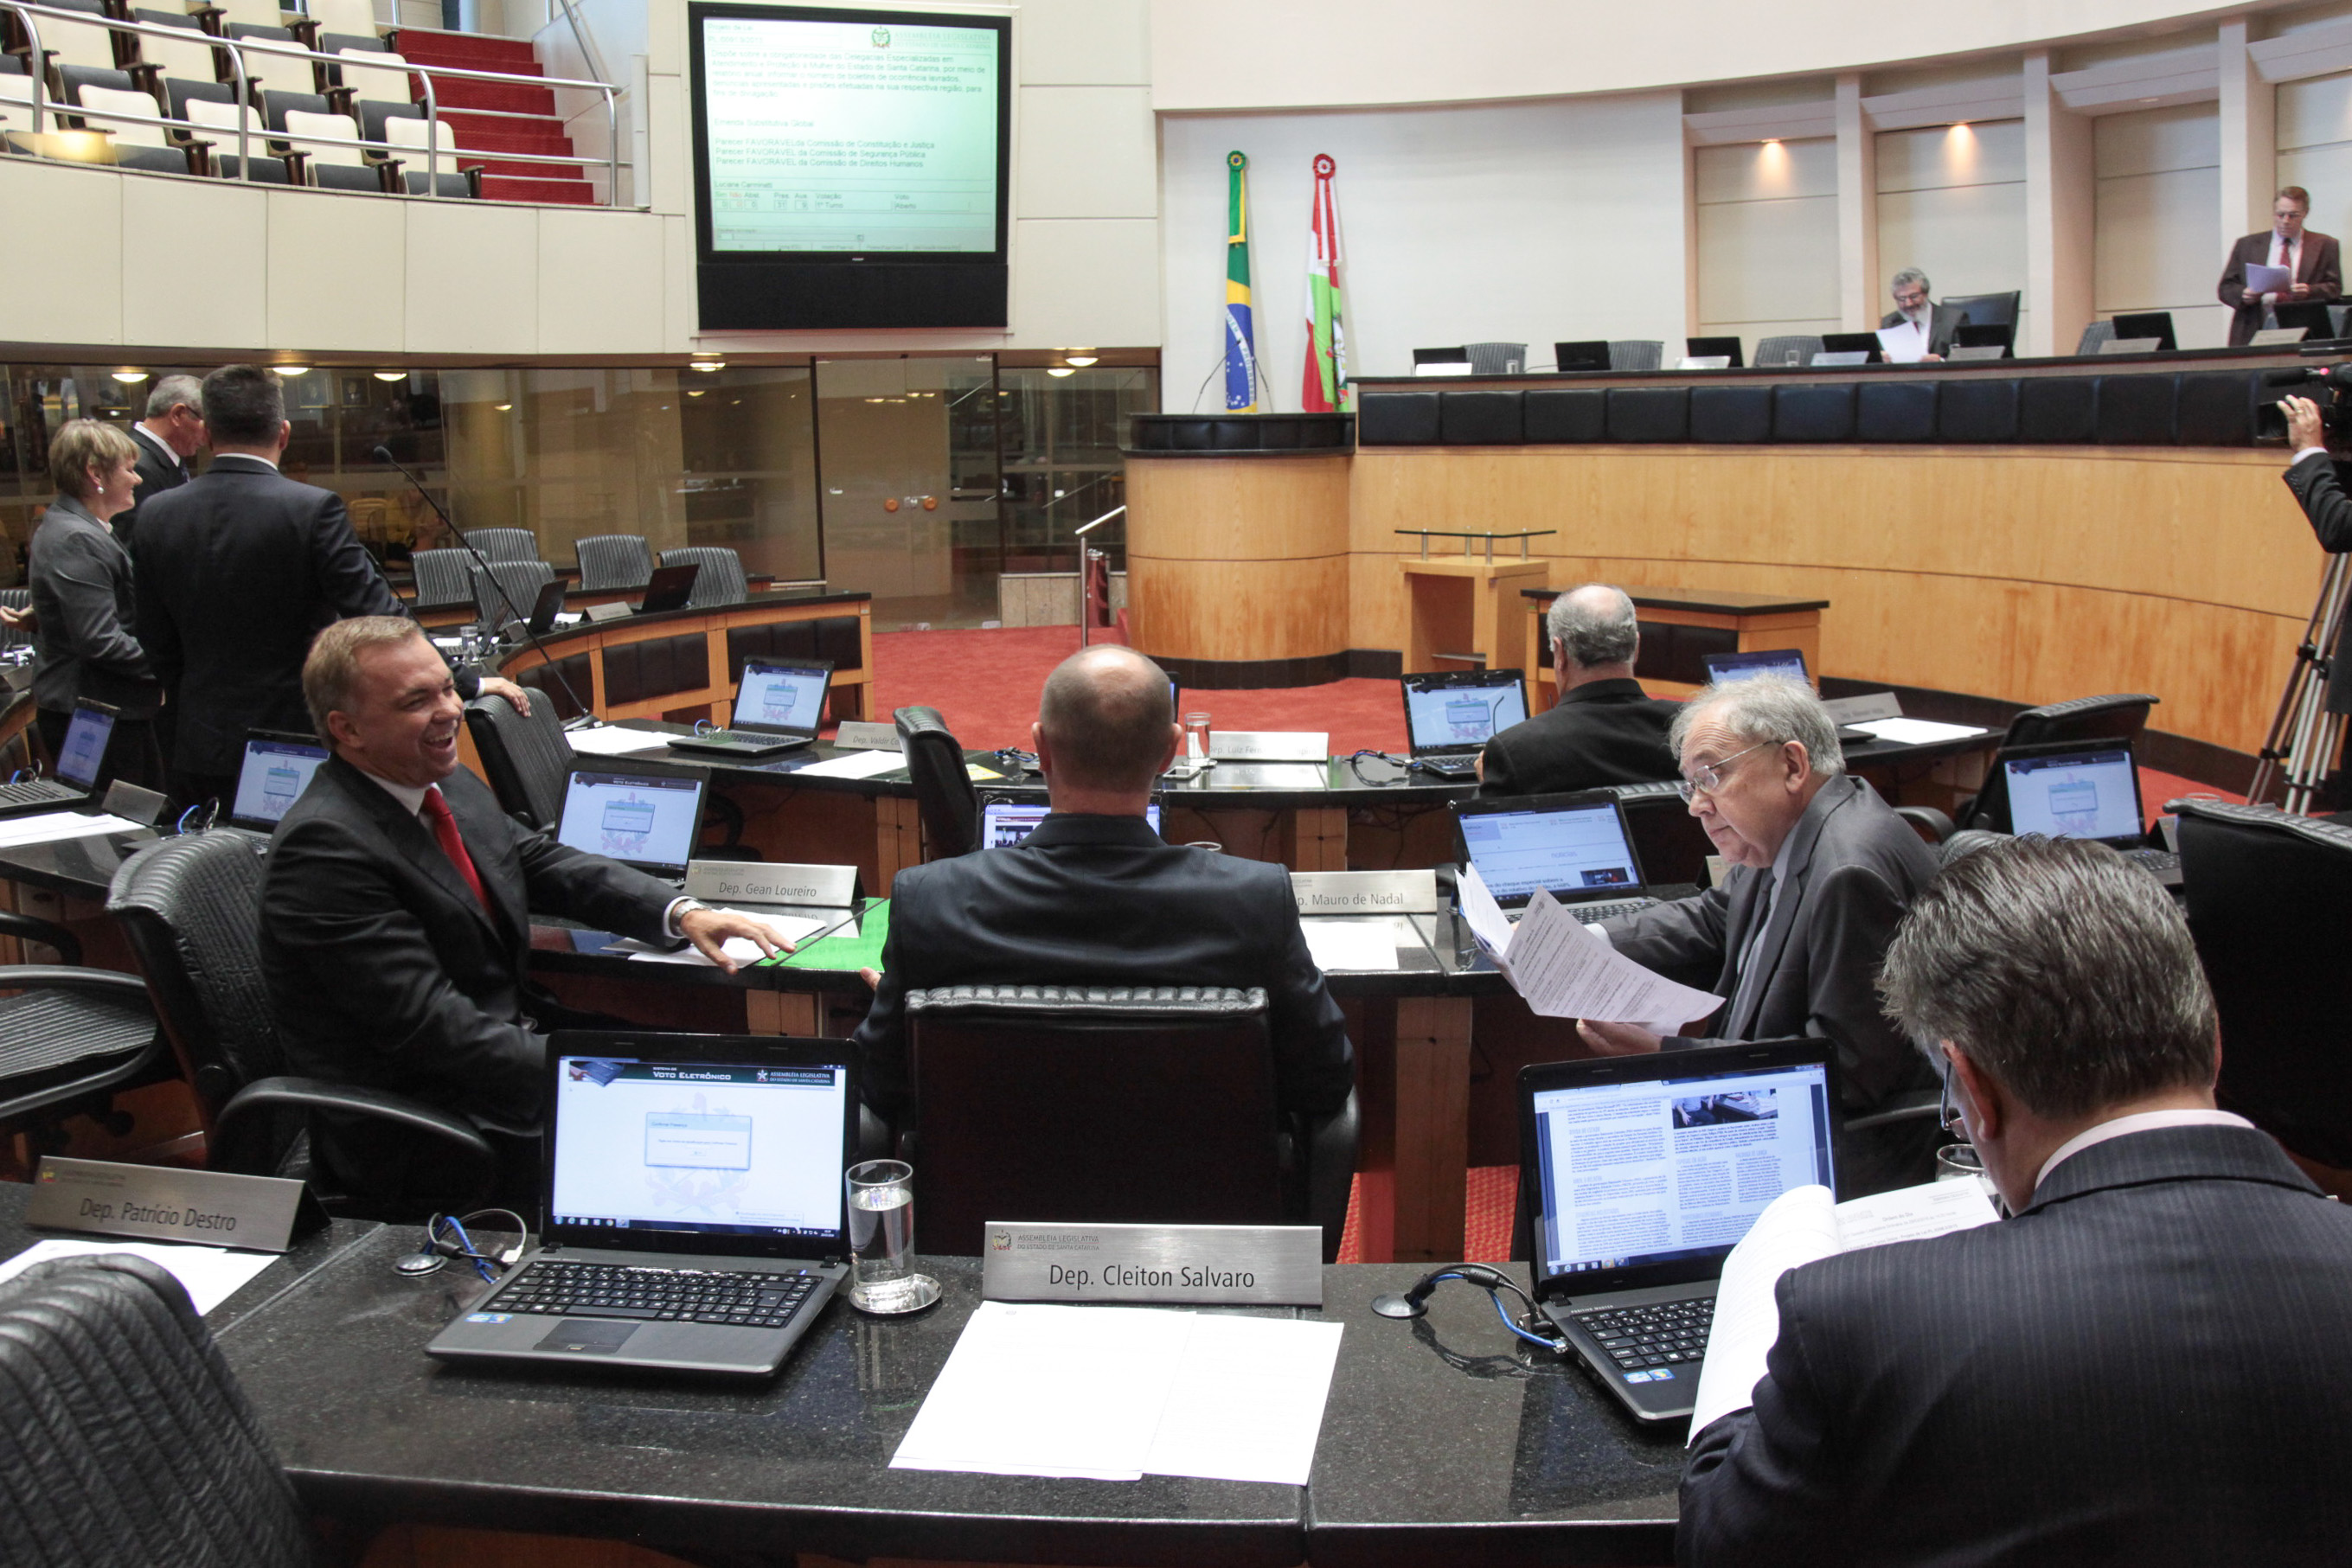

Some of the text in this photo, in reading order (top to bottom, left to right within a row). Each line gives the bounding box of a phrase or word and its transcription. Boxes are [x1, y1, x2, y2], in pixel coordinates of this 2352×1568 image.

[844, 54, 884, 62] Delegacias
[887, 54, 939, 63] Especializadas
[857, 140, 901, 149] Constituição
[853, 736, 867, 745] Dep.
[719, 882, 817, 897] Dep. Gean Loureiro
[1311, 894, 1349, 906] Mauro
[1352, 893, 1367, 905] de
[1370, 893, 1404, 905] Nadal
[80, 1198, 236, 1231] Dep. Patrício Destro
[1050, 1264, 1255, 1290] Dep. Cleiton Salvaro
